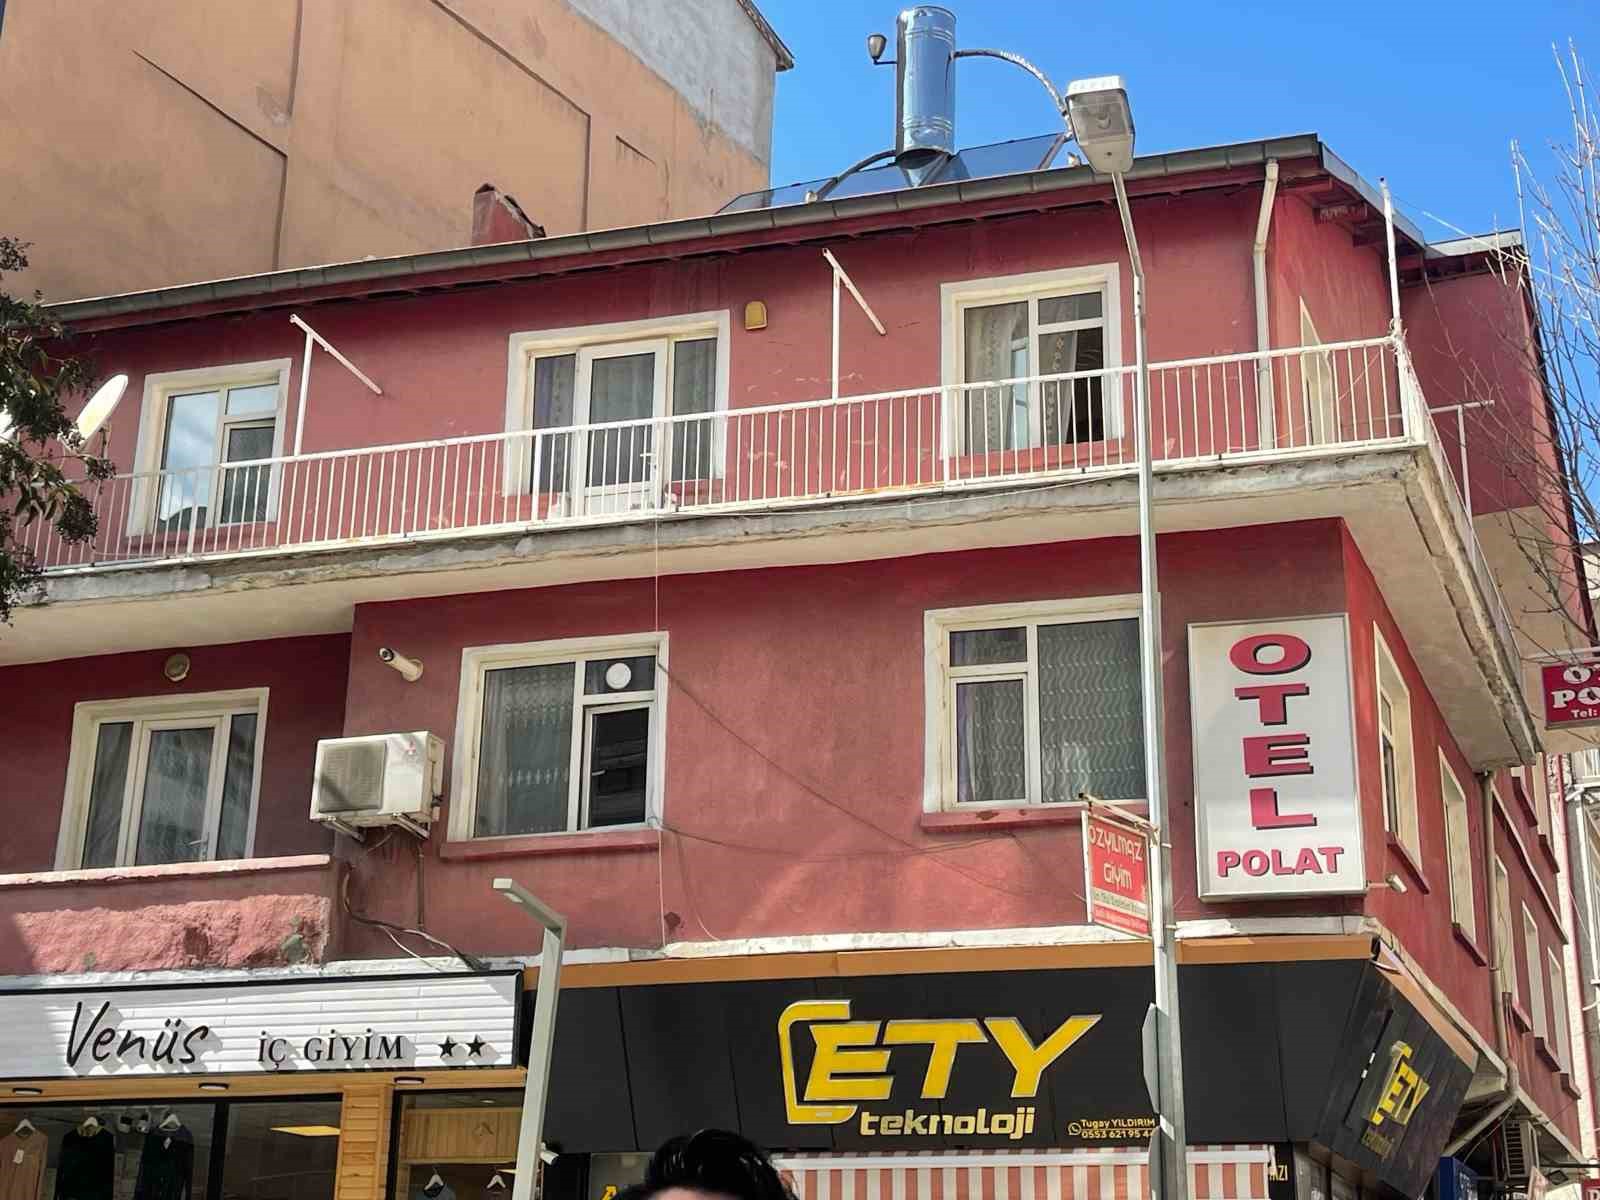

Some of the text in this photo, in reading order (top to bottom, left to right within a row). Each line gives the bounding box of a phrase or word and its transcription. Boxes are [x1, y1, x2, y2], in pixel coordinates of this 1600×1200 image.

[1563, 664, 1600, 684] O
[1571, 708, 1598, 718] Tel:
[1228, 632, 1317, 830] OTEL
[1216, 846, 1345, 878] POLAT
[65, 1000, 210, 1067] Venüs
[257, 1027, 405, 1070] İÇ GİYİM
[803, 1012, 1102, 1101] ETY
[860, 1106, 1036, 1140] teknoloji
[1081, 1130, 1107, 1139] 0553
[1128, 1129, 1141, 1138] 95
[1111, 1118, 1156, 1129] YILDIRIM
